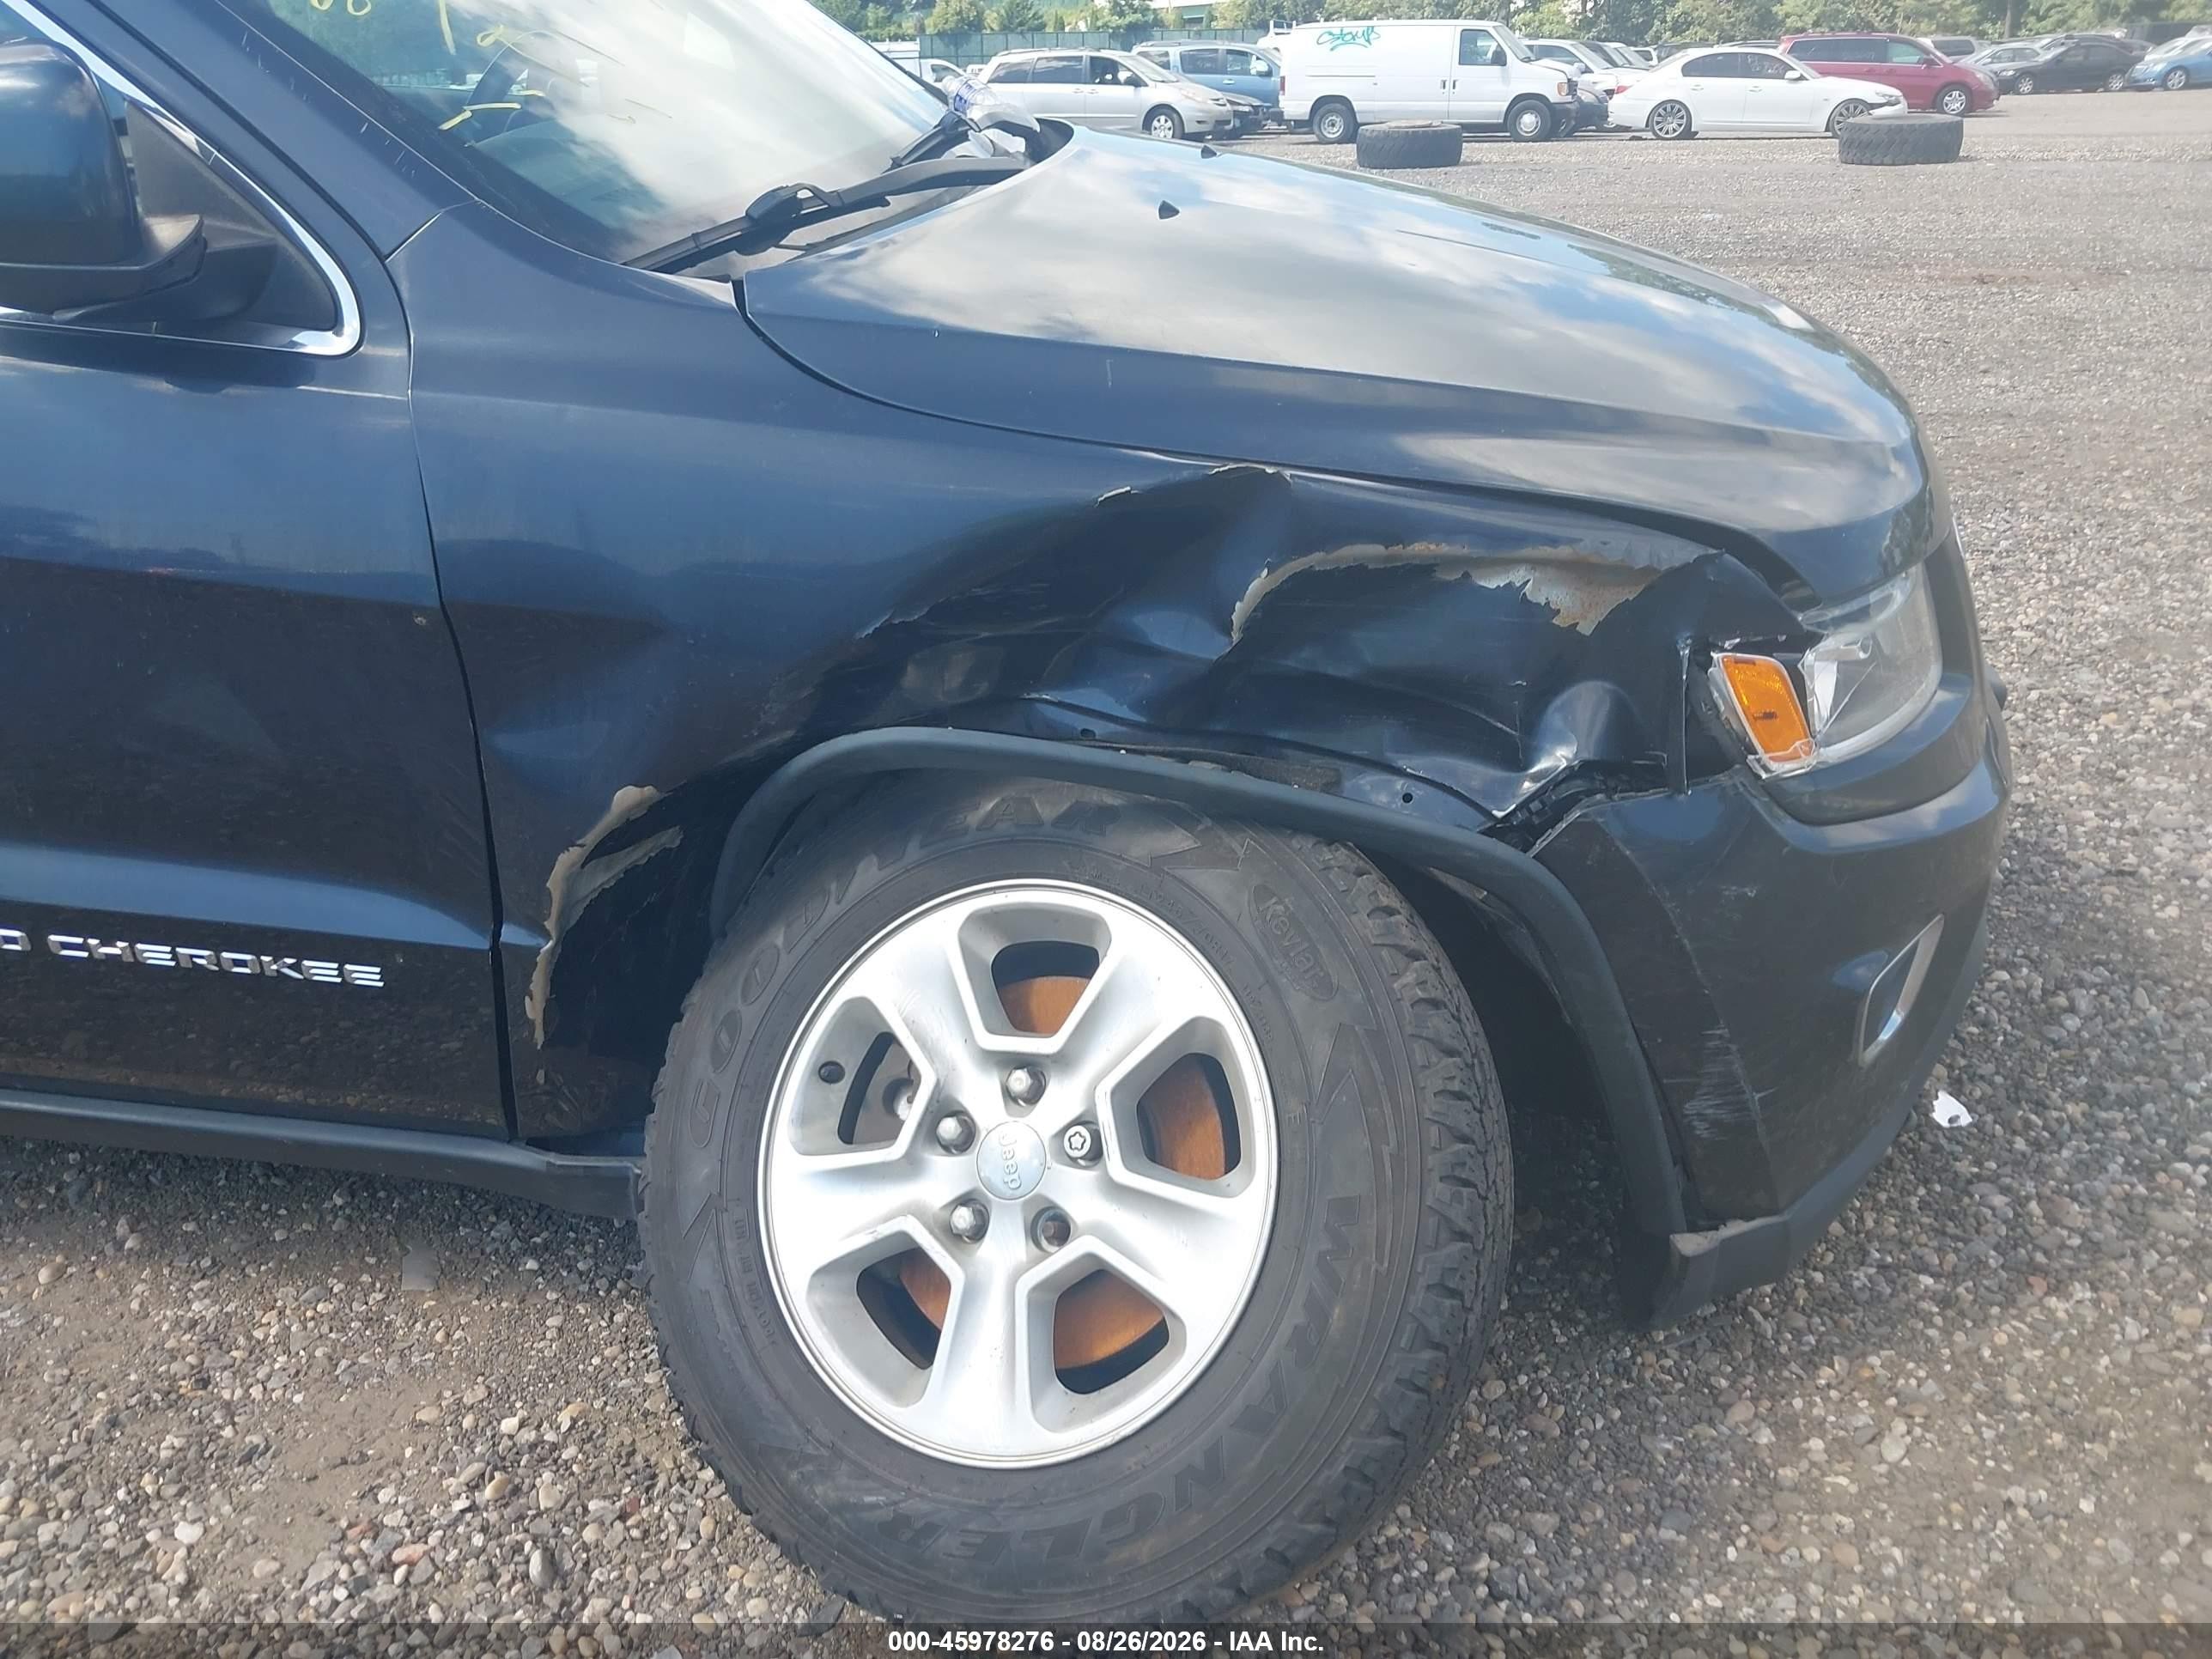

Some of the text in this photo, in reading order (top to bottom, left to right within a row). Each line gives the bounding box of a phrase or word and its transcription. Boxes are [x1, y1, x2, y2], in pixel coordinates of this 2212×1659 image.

[46, 933, 386, 988] CHEROKEE
[998, 1132, 1024, 1192] Jeep
[874, 1194, 1362, 1565] WRANGLER
